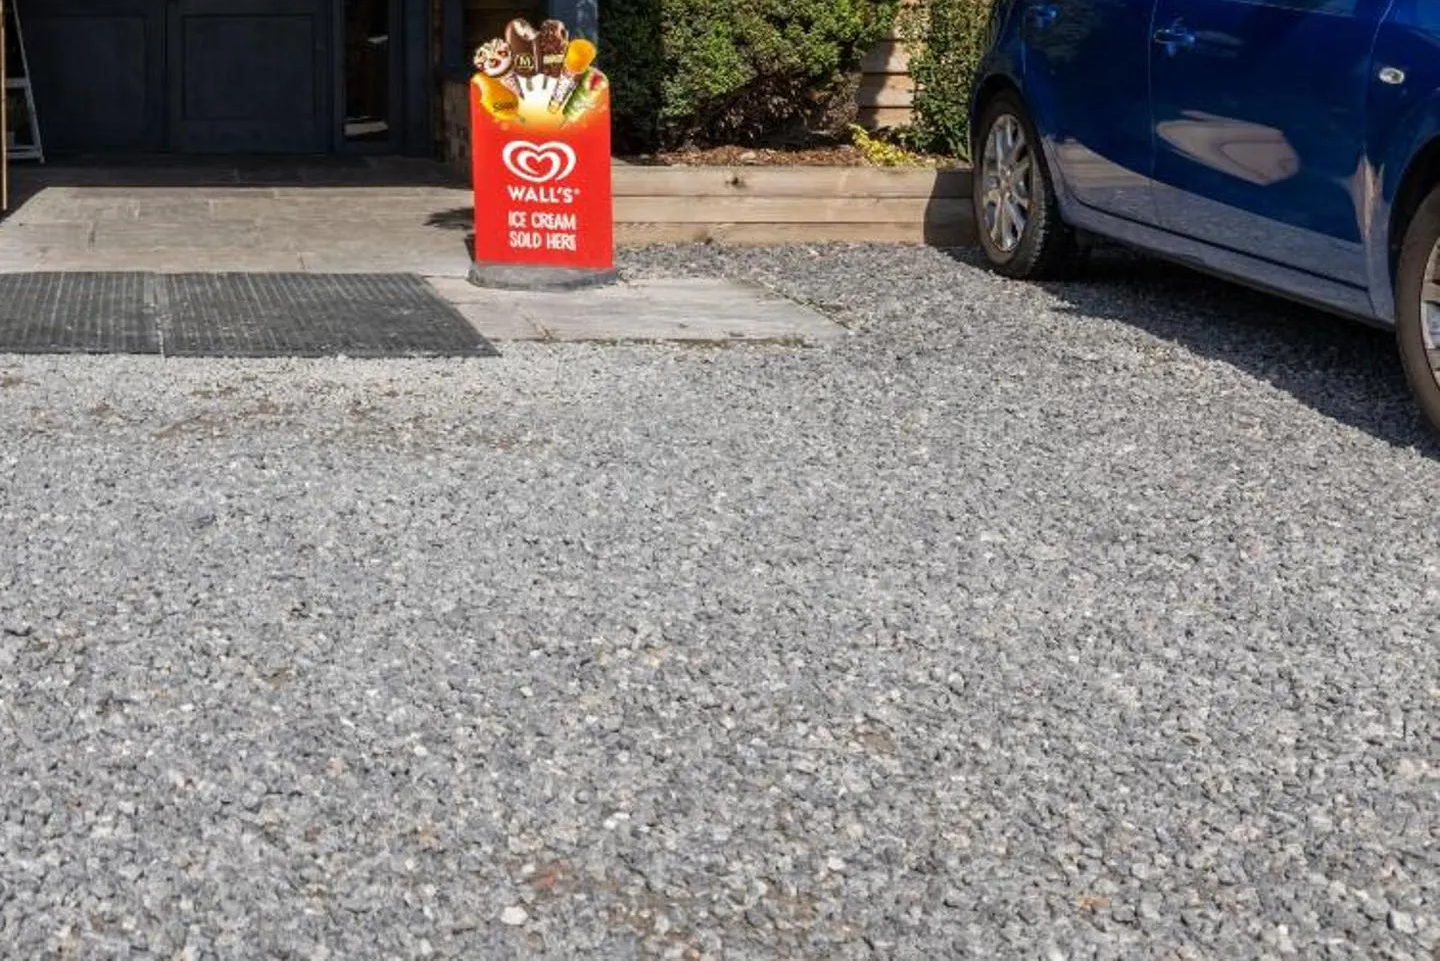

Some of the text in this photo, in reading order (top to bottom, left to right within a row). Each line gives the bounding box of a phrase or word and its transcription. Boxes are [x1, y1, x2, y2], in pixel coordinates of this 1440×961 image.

[507, 185, 574, 204] WALL'S
[508, 211, 577, 230] ICE CREAM
[509, 231, 577, 251] SOLD HERE
